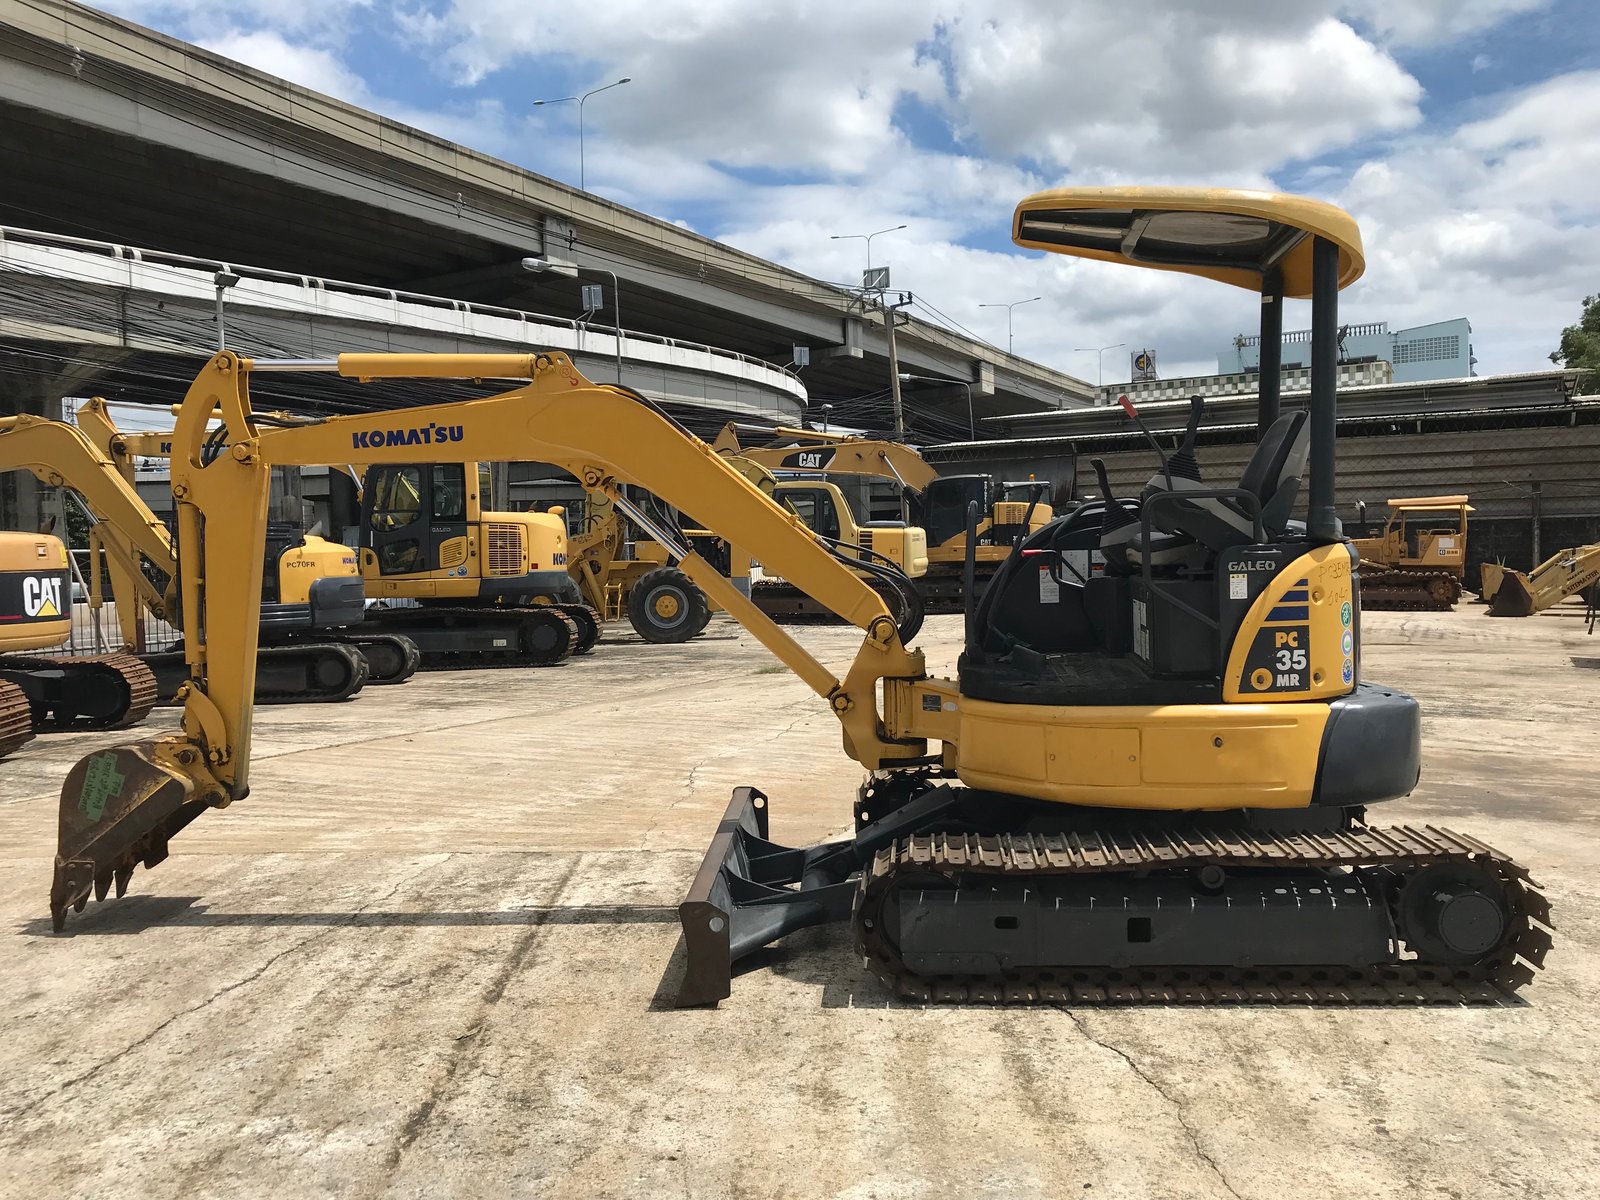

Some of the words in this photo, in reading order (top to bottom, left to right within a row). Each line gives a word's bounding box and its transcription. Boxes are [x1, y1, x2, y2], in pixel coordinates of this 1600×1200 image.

[352, 423, 464, 448] KOMATSU
[799, 453, 822, 467] CAT
[286, 561, 316, 569] PC70FR
[1228, 561, 1276, 571] GALEO
[1567, 570, 1600, 592] SITEMASTER
[23, 576, 62, 617] CAT
[1275, 631, 1299, 648] PC
[1276, 649, 1307, 671] 35
[1276, 673, 1300, 687] MR
